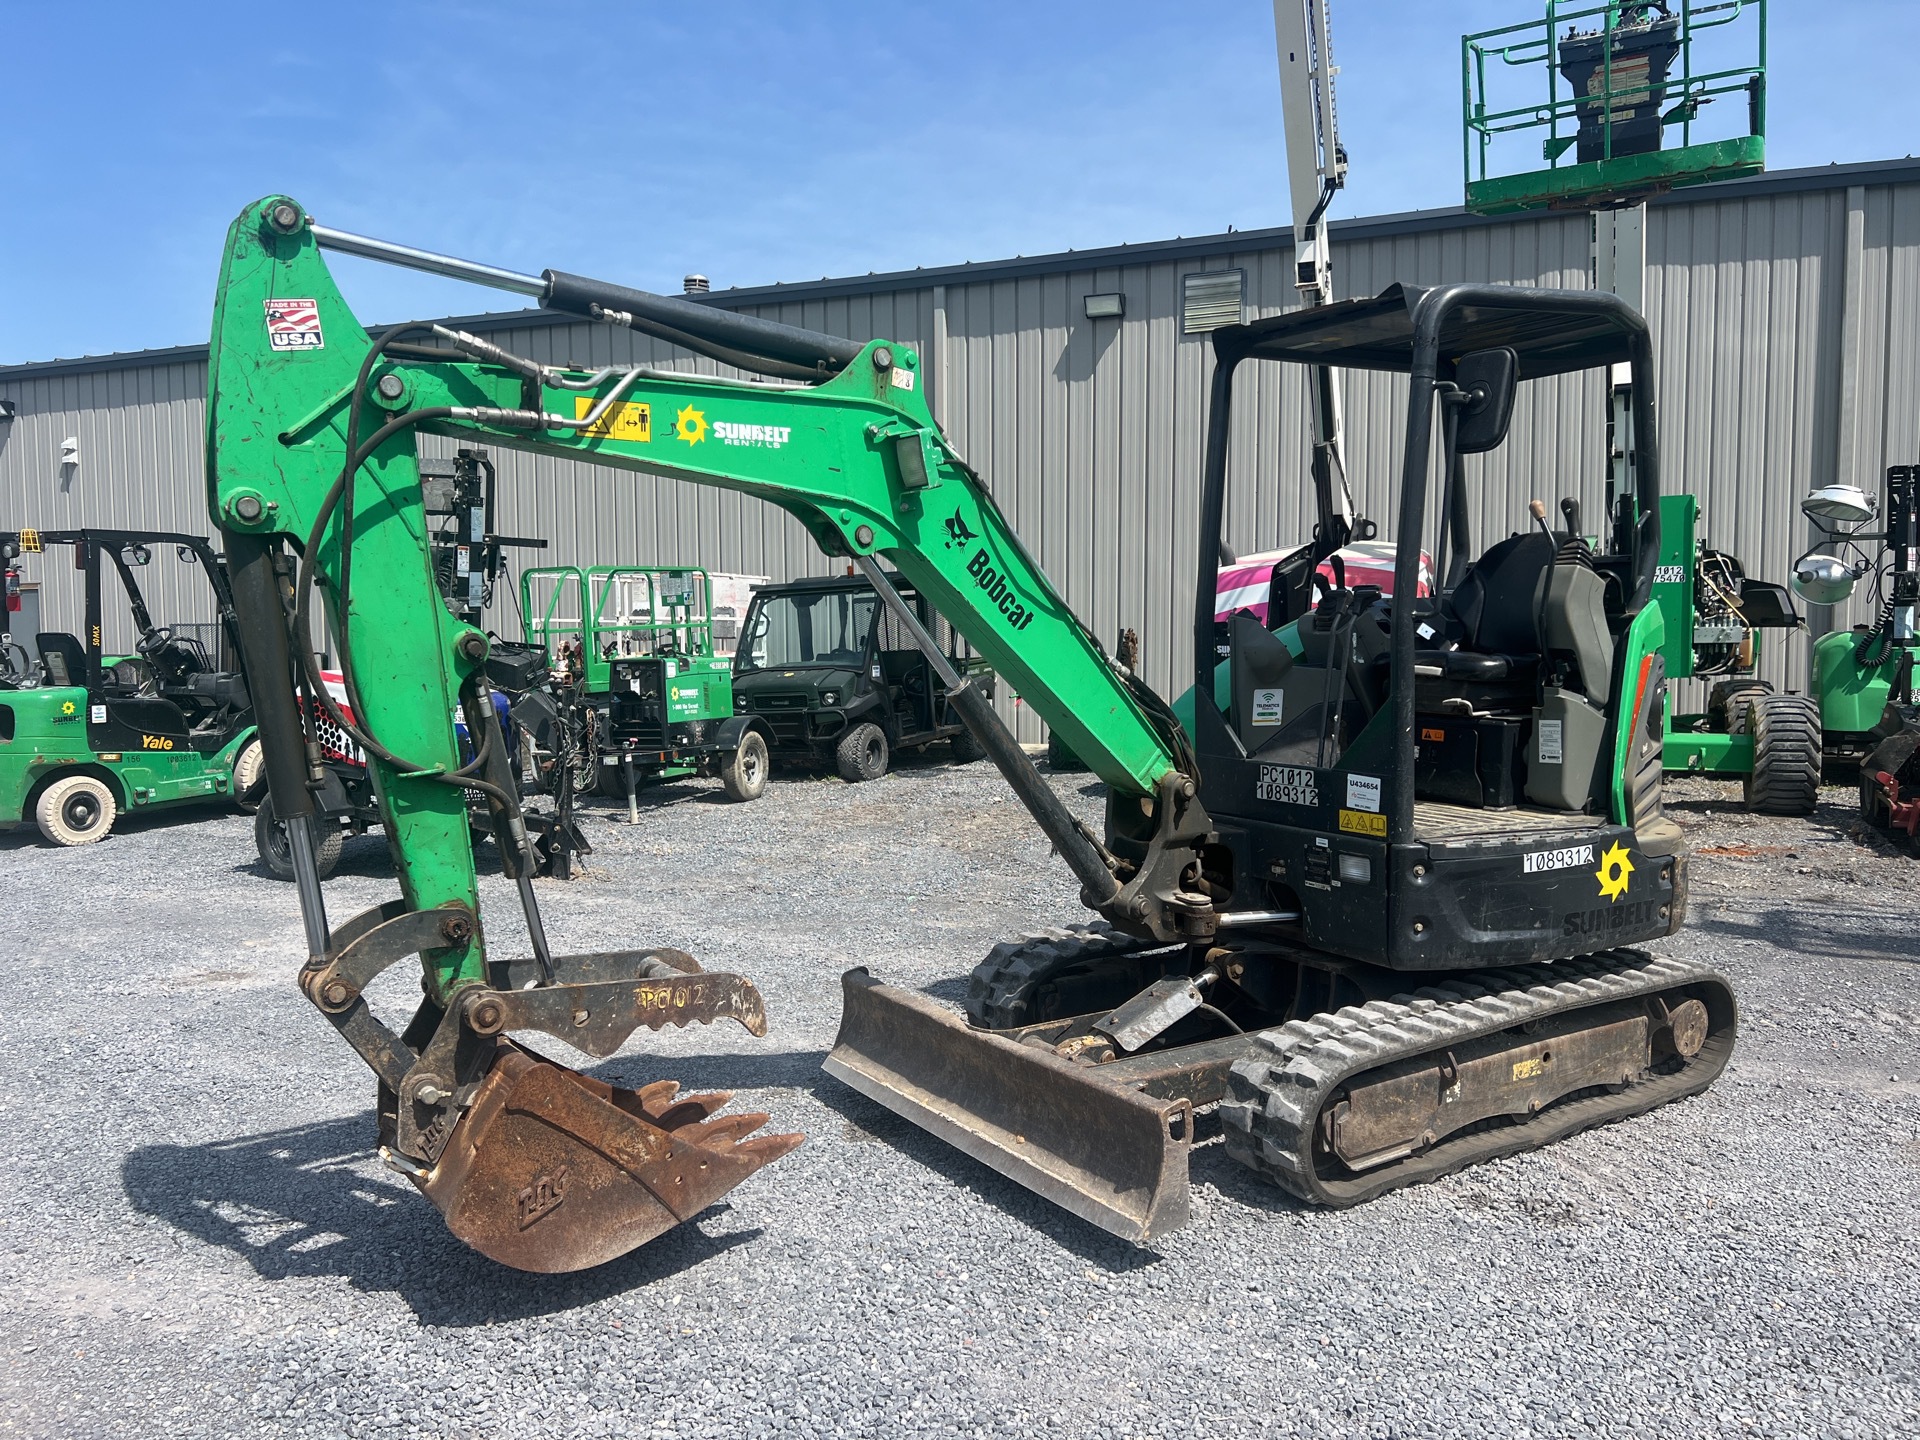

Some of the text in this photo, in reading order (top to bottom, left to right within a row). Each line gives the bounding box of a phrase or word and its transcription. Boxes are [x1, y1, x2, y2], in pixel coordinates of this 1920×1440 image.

[273, 332, 320, 346] USA
[712, 421, 791, 443] SUNBELT
[966, 547, 1034, 631] Bobcat
[142, 735, 173, 750] Yale
[1261, 766, 1313, 788] PC1012
[1349, 780, 1379, 791] U434654
[1257, 783, 1318, 806] 1089312
[1525, 846, 1593, 872] 1089312
[1563, 900, 1655, 937] SUNBELT
